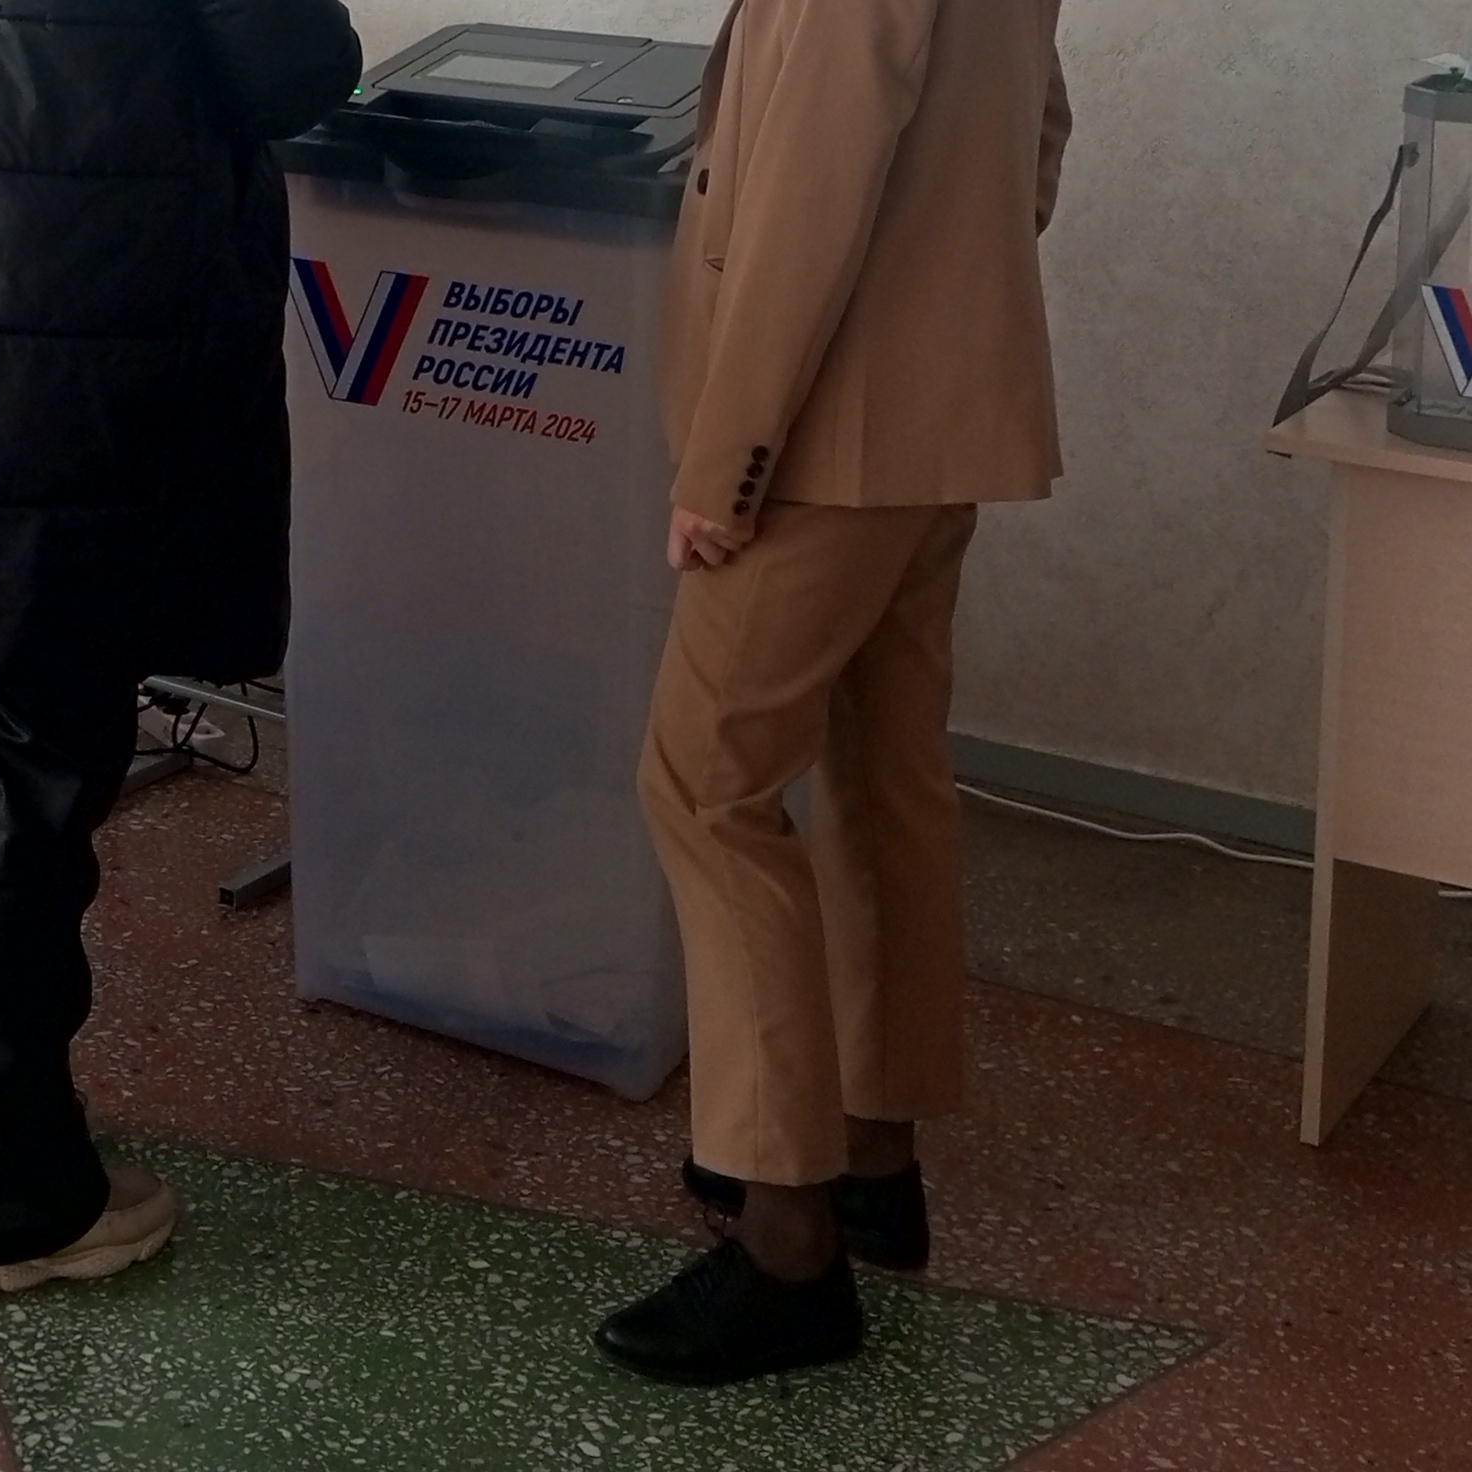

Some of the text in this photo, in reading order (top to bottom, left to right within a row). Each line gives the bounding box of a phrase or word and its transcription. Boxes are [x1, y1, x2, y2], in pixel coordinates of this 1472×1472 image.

[442, 281, 584, 326] ВЫБОРЫ
[427, 318, 626, 374] ПРЕЗИДЕНТА
[412, 354, 538, 399] РОССИИ
[461, 399, 537, 434] МАРТА
[540, 413, 597, 445] 2024
